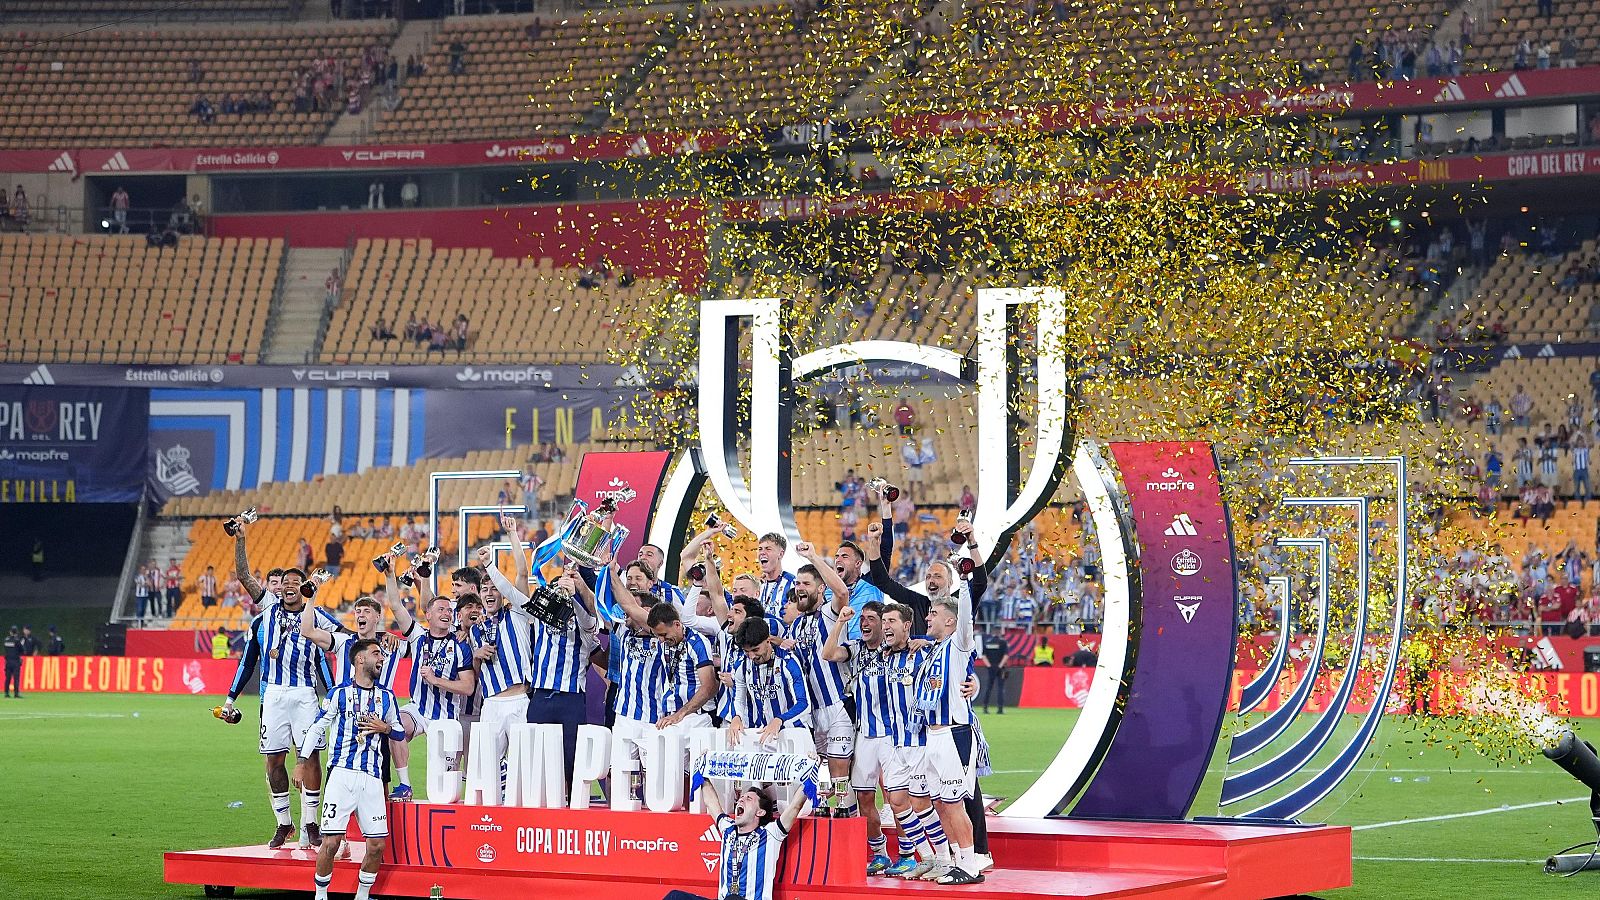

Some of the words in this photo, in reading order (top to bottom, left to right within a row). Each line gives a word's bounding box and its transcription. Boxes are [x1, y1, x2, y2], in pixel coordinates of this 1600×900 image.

[197, 154, 232, 165] Estrella
[233, 153, 266, 164] Galicia
[356, 151, 425, 161] CUPRA
[1508, 157, 1538, 176] COPA
[1541, 154, 1562, 174] DEL
[1564, 152, 1585, 172] REY
[125, 370, 168, 382] Estrella
[169, 369, 208, 383] Galicia
[308, 370, 390, 381] CUPRA
[483, 367, 553, 384] mapfre
[60, 402, 102, 440] REY
[16, 450, 69, 462] mapfre
[1146, 480, 1195, 492] mapfre
[9, 656, 164, 692] AMPEONES
[322, 802, 337, 819] 23
[470, 823, 502, 833] mapfre
[516, 827, 553, 854] COPA
[557, 829, 580, 855] DEL
[585, 830, 611, 856] REY
[620, 838, 679, 853] mapfre
